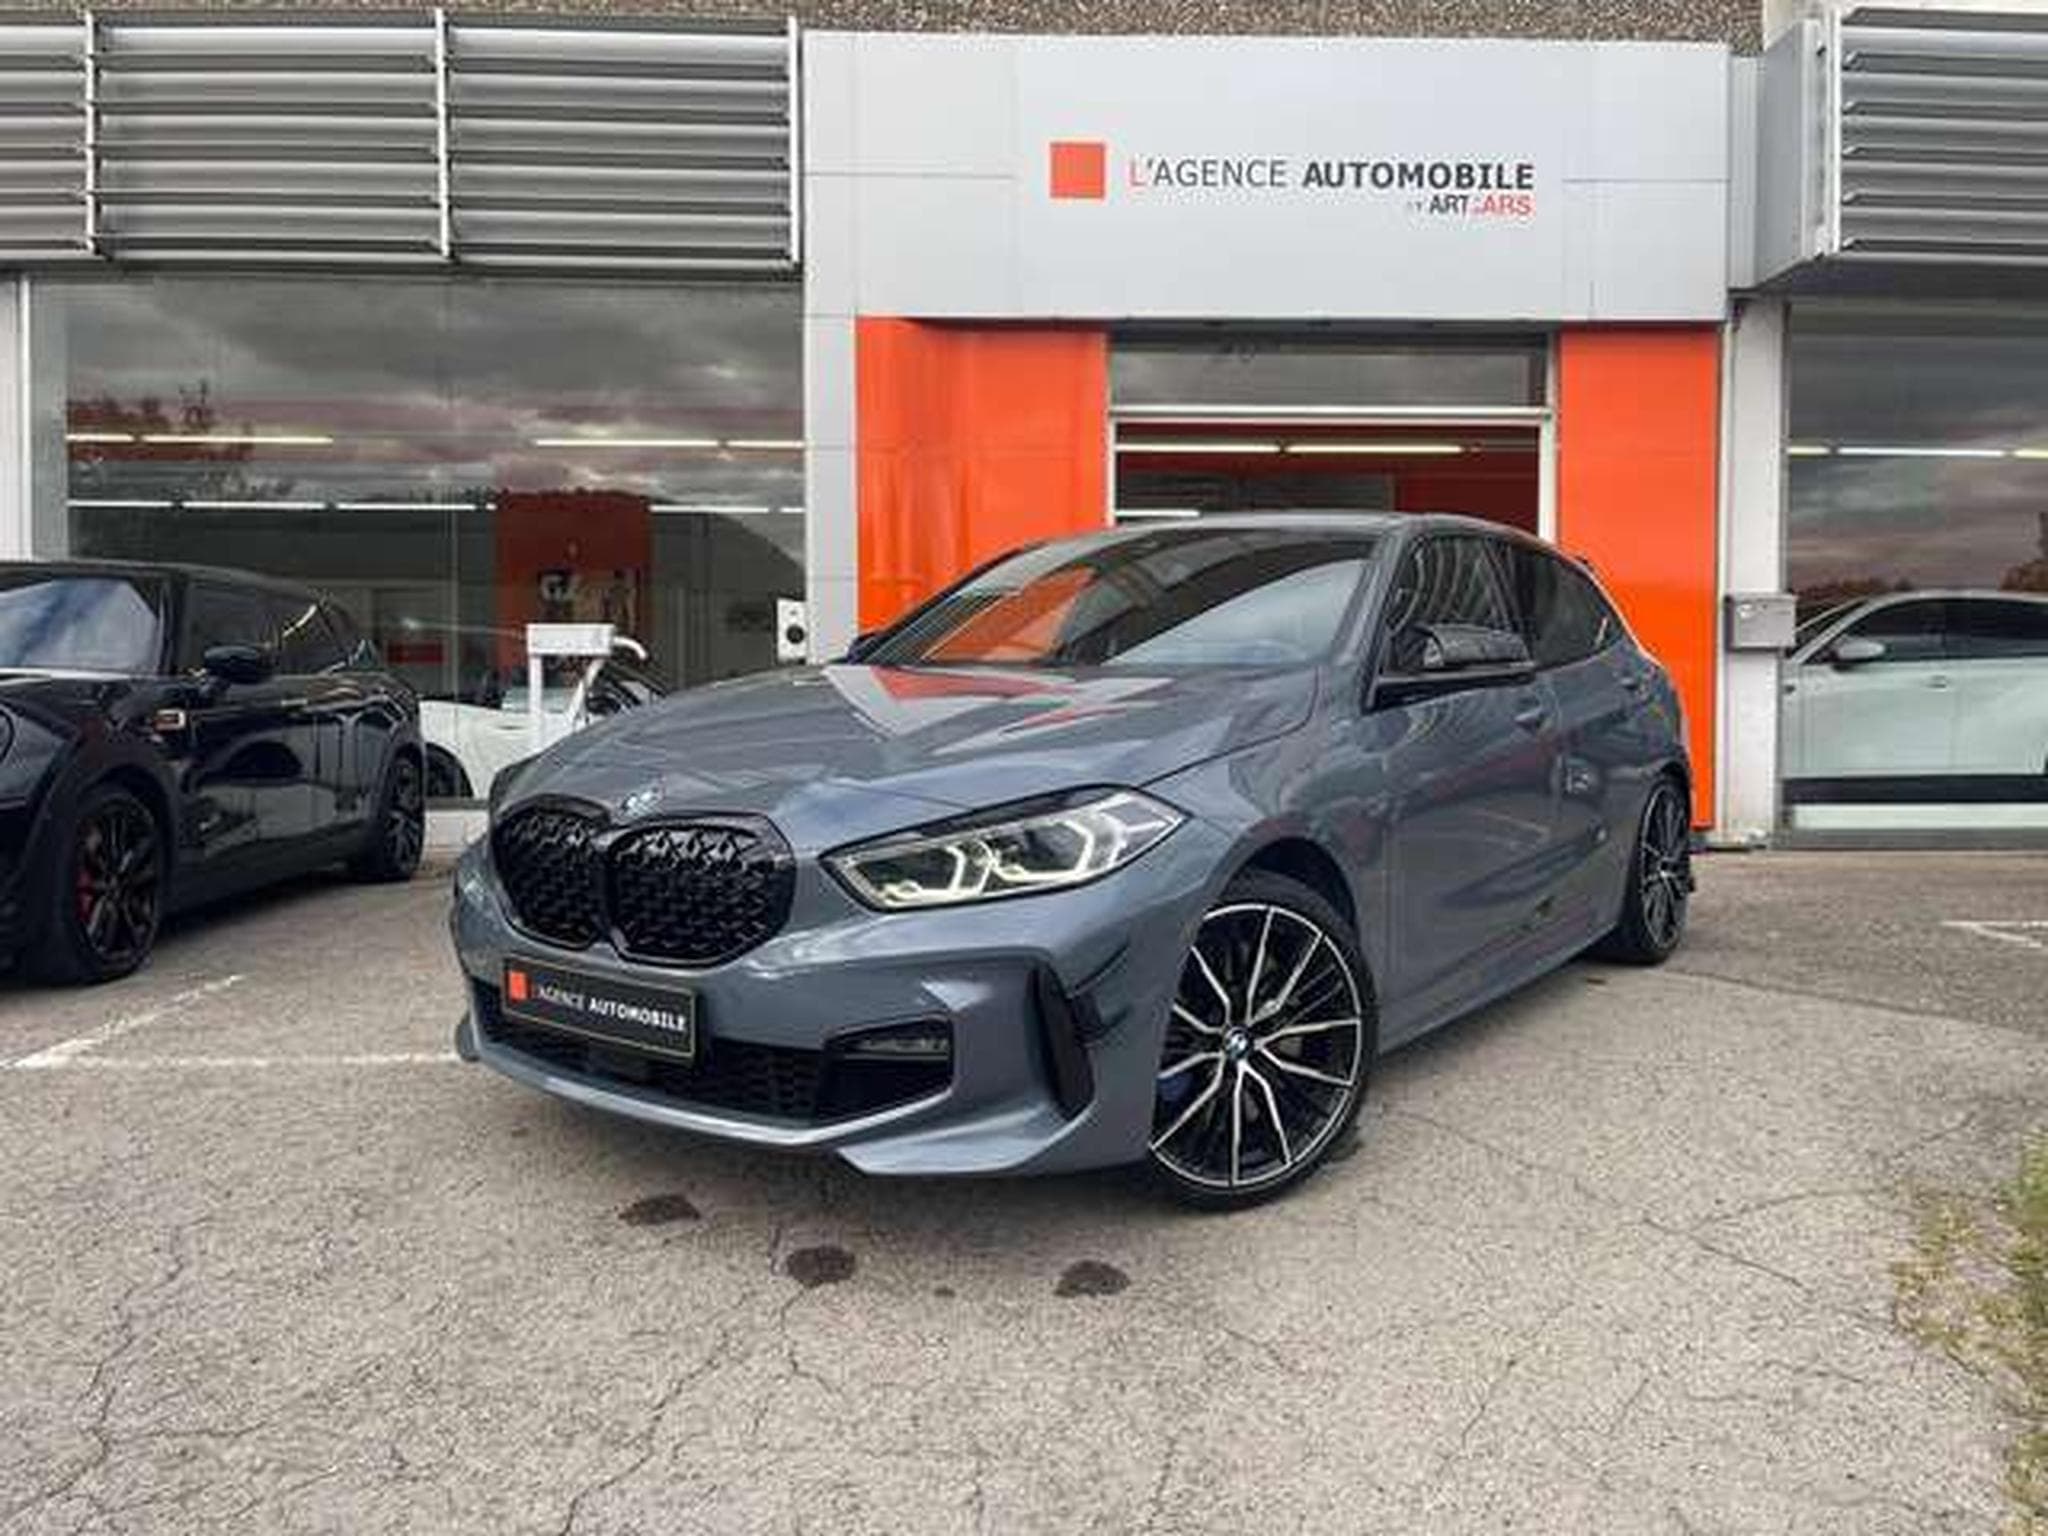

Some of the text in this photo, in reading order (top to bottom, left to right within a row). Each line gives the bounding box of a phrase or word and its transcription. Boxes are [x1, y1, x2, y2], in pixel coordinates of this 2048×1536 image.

[1129, 157, 1535, 190] L'AGENCE AUTOMOBILE
[588, 997, 687, 1033] AUTOMOBILE
